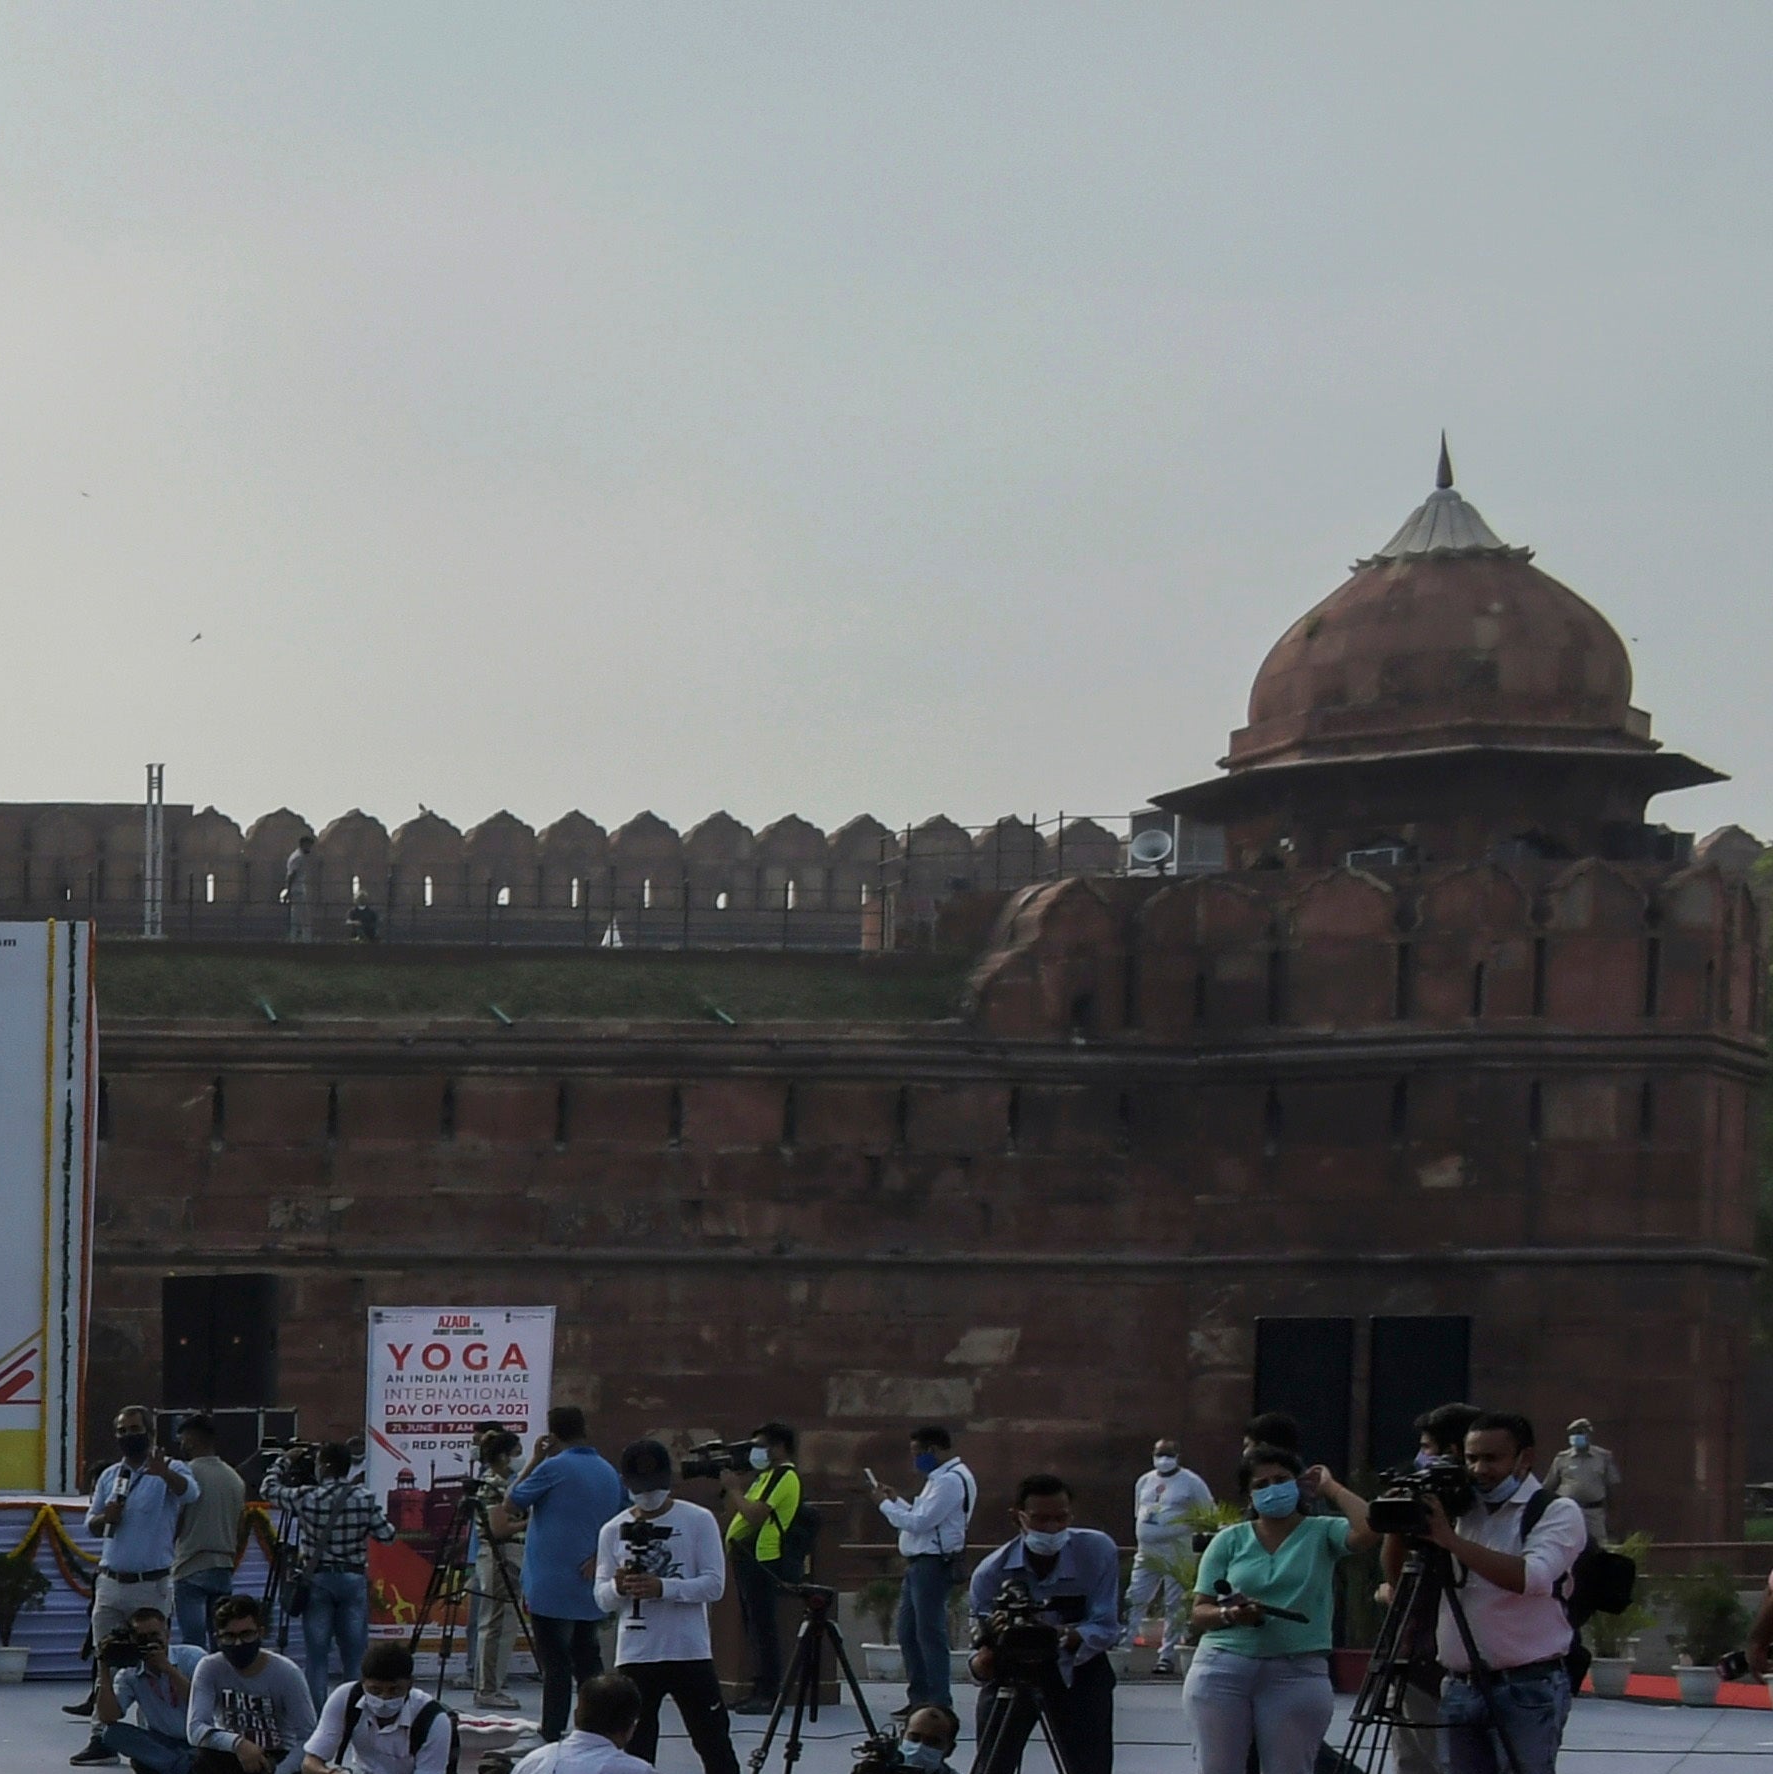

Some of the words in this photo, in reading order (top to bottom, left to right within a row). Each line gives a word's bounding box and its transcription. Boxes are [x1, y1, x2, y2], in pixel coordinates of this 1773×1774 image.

[387, 1343, 528, 1371] YOGA
[386, 1374, 404, 1383] AN
[410, 1374, 457, 1383] INDIAN
[463, 1373, 530, 1383] HERITAGE
[385, 1387, 529, 1400] INTERNATIONAL
[385, 1404, 417, 1416] DAY
[421, 1404, 443, 1416] OF
[448, 1404, 492, 1416] YOGA
[496, 1403, 529, 1416] 2021
[405, 1421, 435, 1433] JUNE
[448, 1422, 455, 1432] 7
[456, 1422, 475, 1432] AM
[412, 1440, 438, 1451] RED
